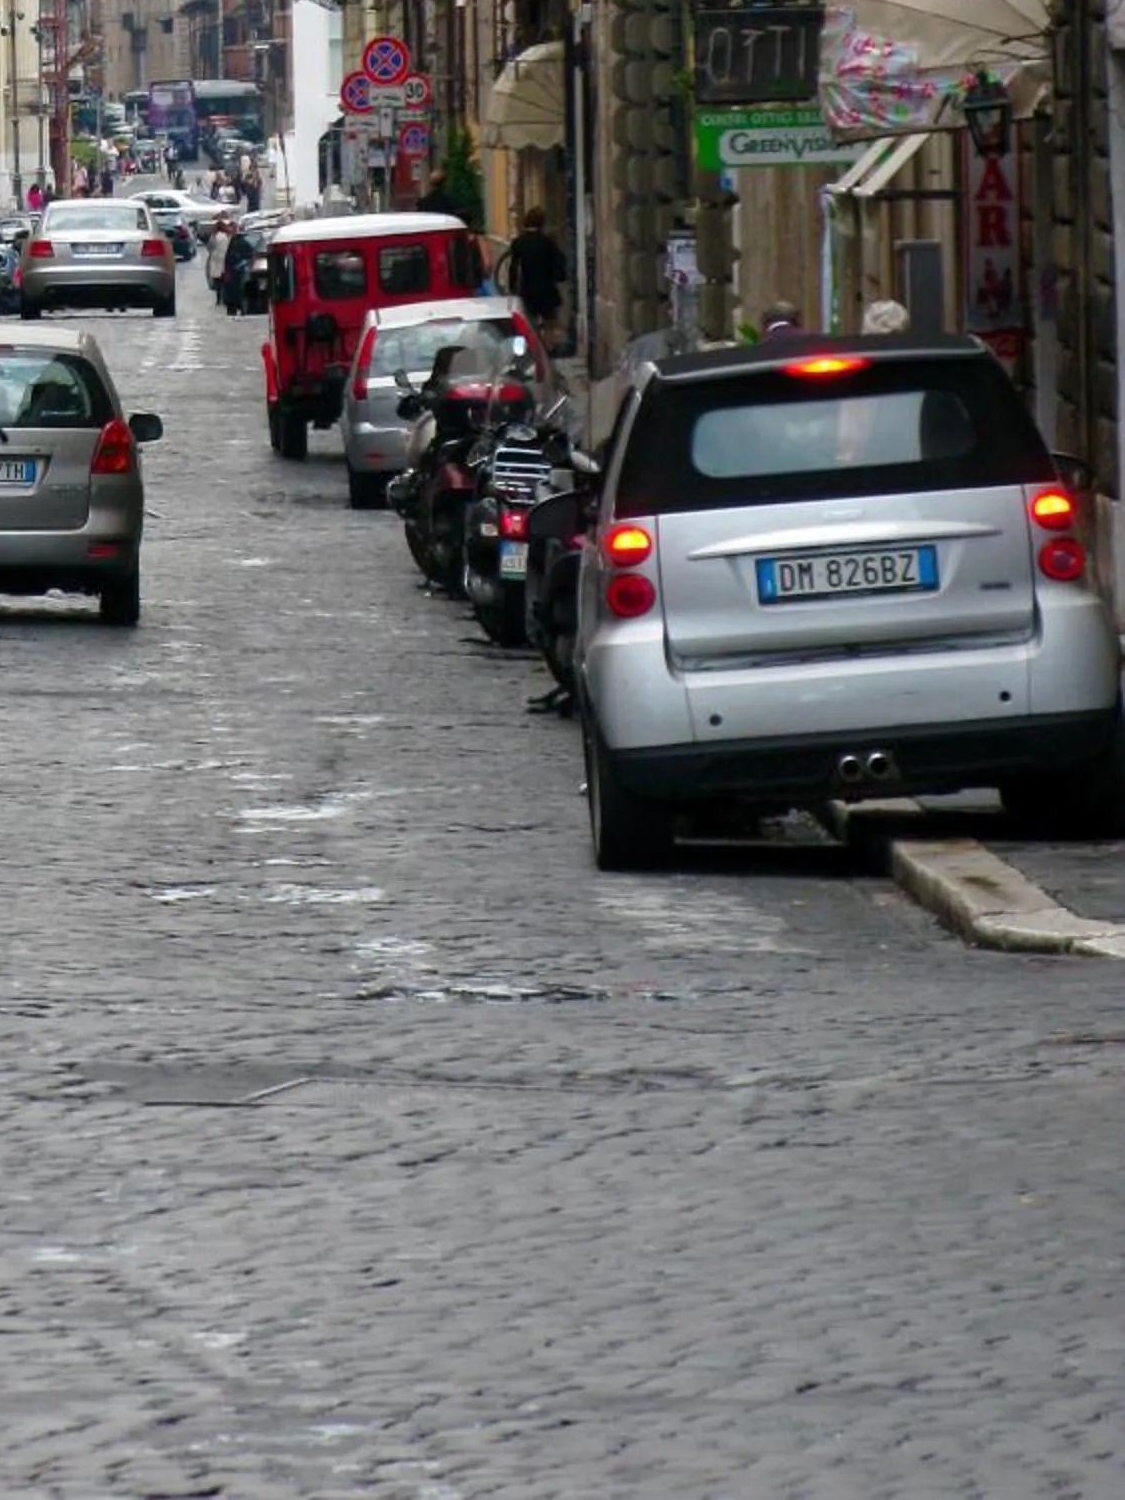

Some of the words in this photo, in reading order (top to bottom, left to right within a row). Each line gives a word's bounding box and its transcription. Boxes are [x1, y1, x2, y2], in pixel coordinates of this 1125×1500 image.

[406, 83, 423, 98] 30
[976, 120, 1014, 247] AR
[779, 562, 814, 592] DM
[826, 554, 916, 588] 826BZ
